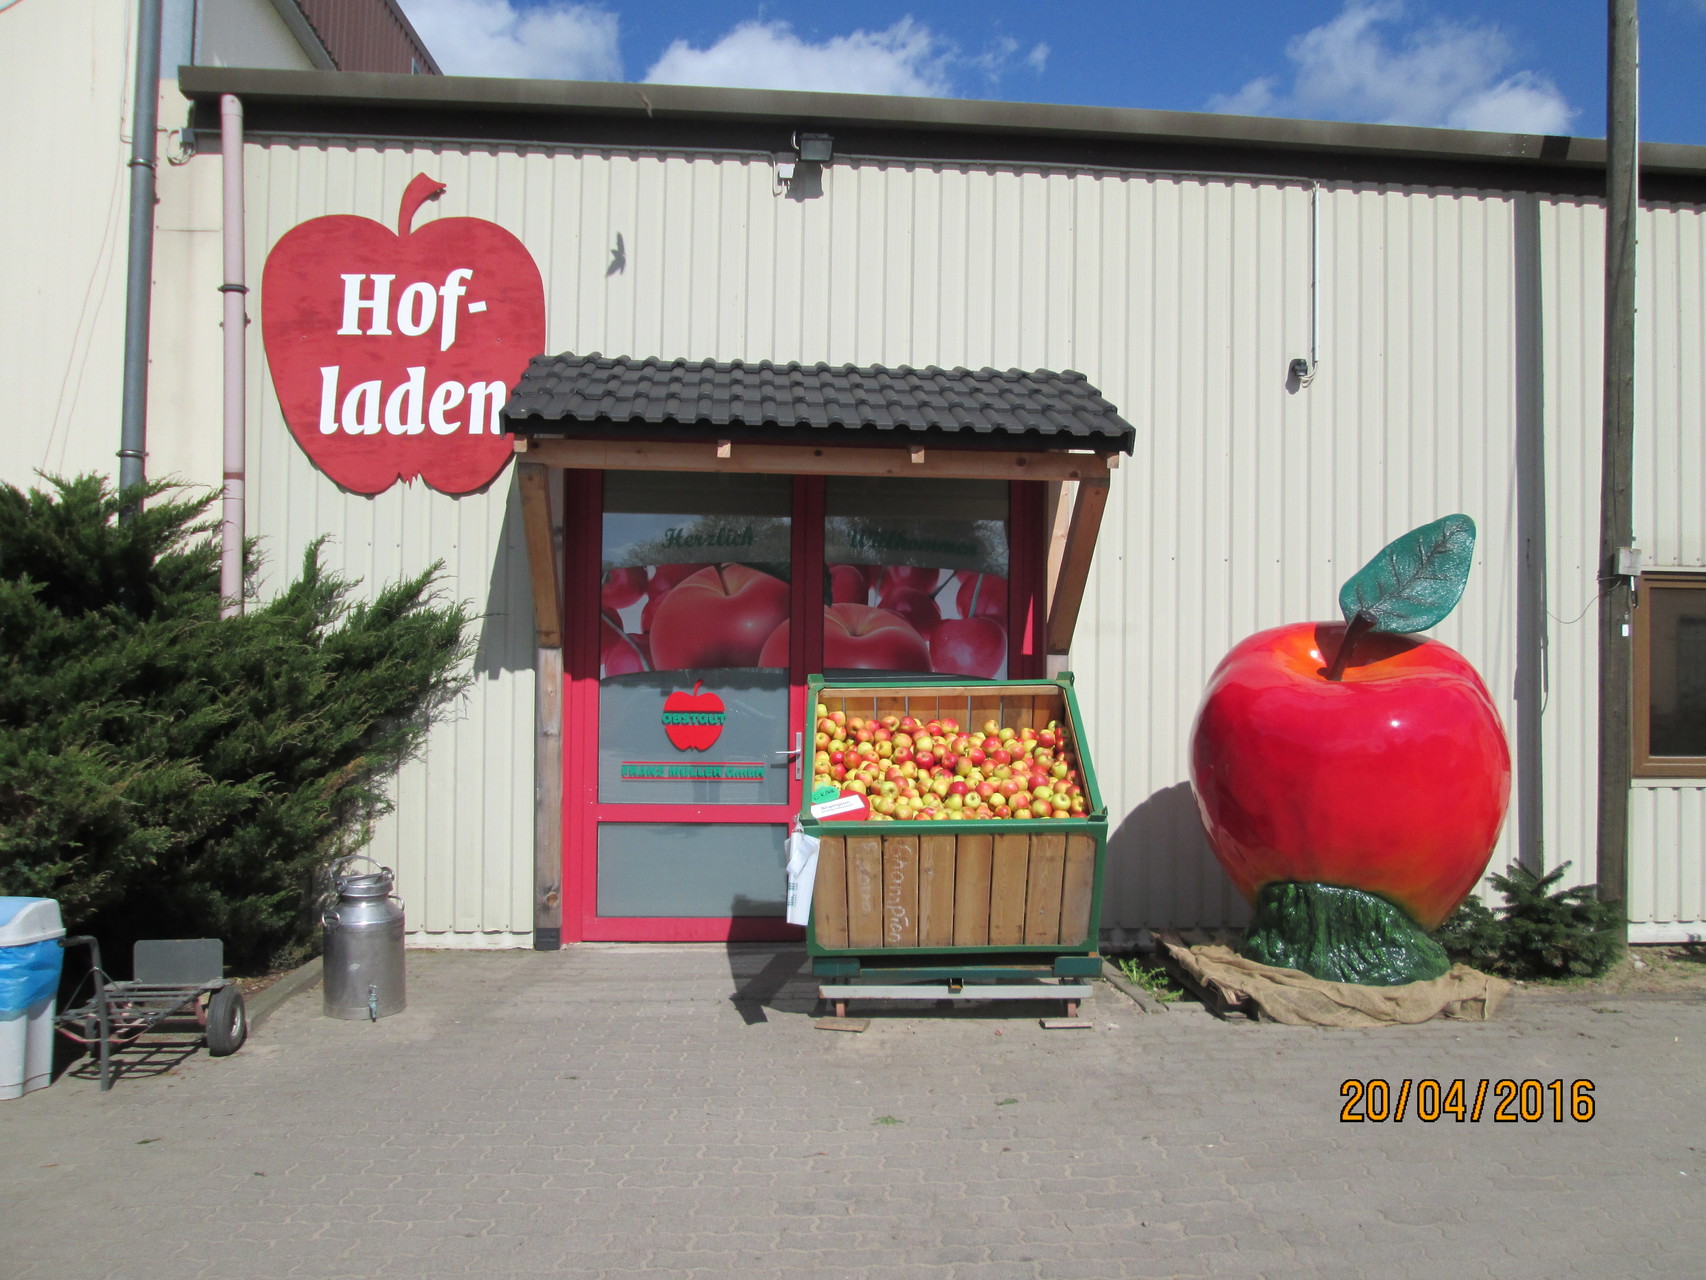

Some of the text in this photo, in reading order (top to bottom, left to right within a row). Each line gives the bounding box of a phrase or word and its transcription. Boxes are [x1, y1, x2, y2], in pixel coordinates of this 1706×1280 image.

[337, 268, 487, 352] Hof-
[319, 366, 507, 435] laden
[661, 525, 754, 549] Herzlich
[662, 712, 727, 724] OBSTGUT
[622, 765, 664, 777] FRANZ
